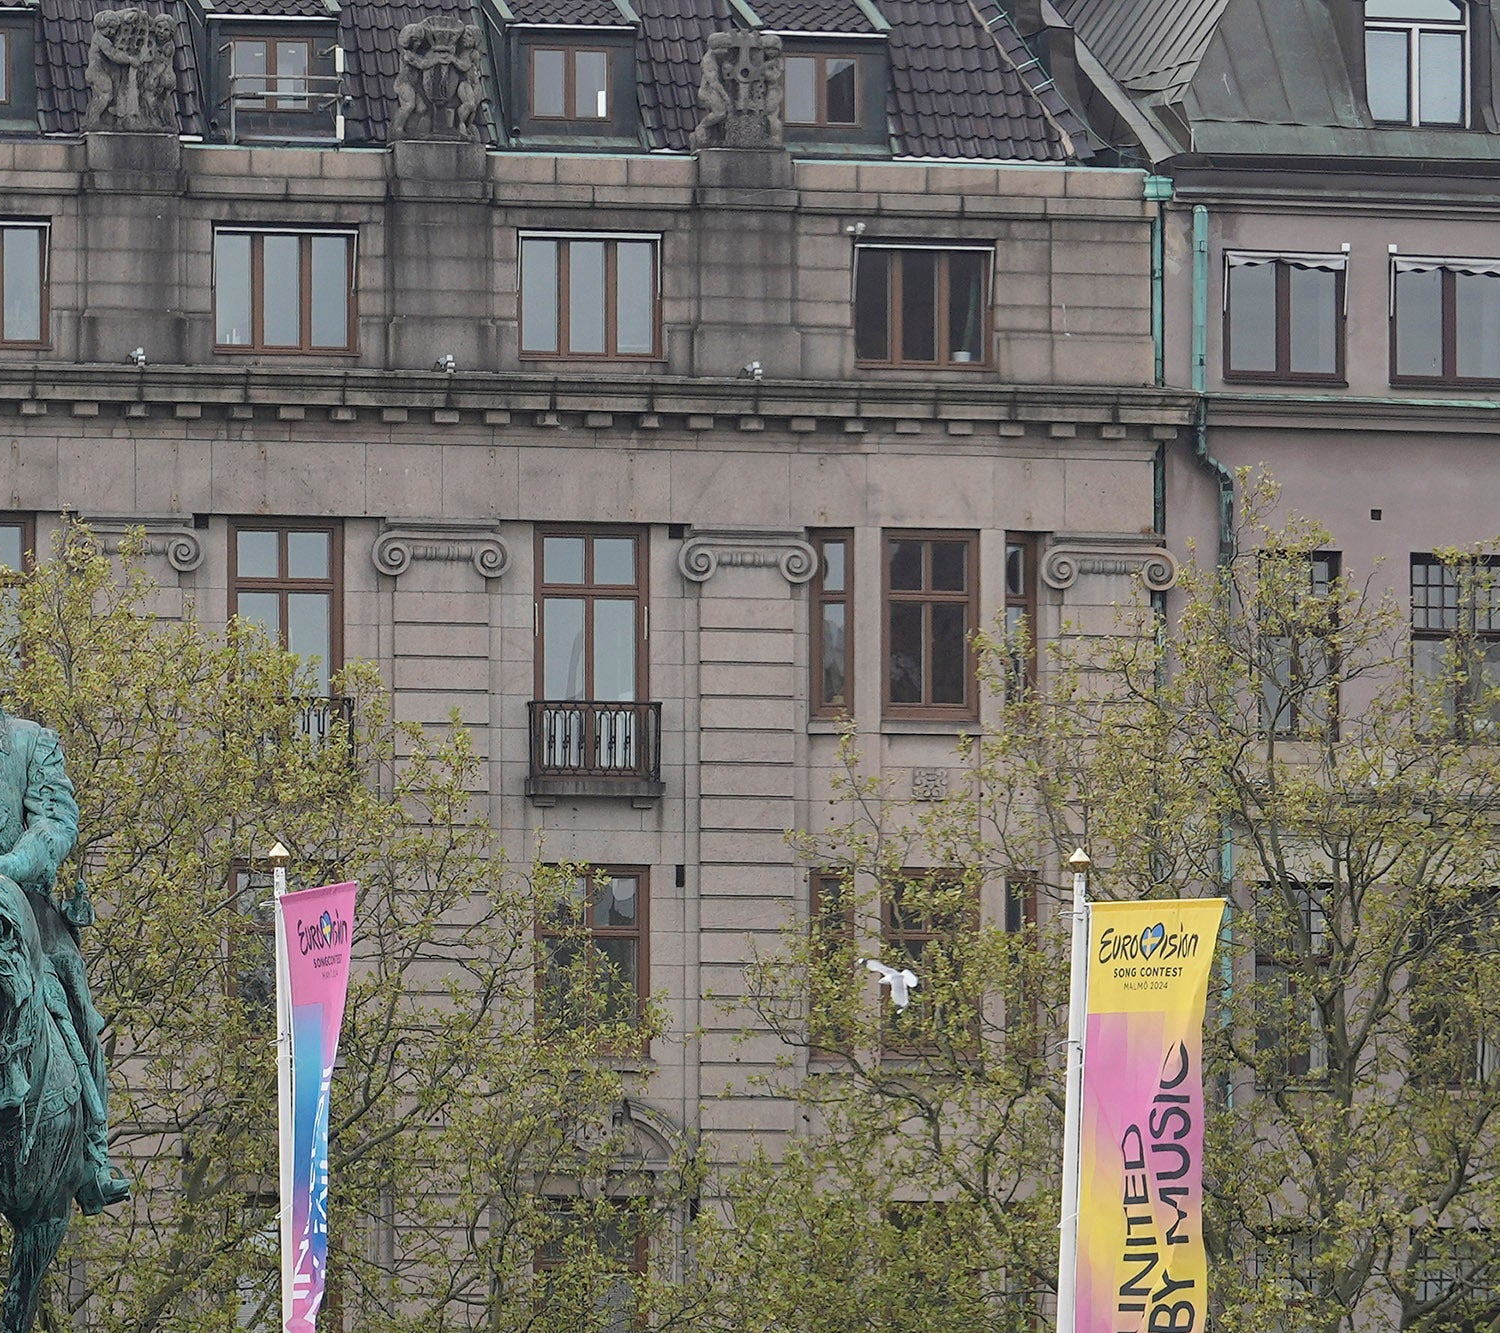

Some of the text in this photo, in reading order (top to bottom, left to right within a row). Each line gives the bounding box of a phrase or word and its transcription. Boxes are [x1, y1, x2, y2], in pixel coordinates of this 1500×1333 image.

[1113, 966, 1183, 978] SONG CONTEST
[1123, 980, 1169, 992] MALMÖ 2024
[1149, 1039, 1192, 1246] MUSIC
